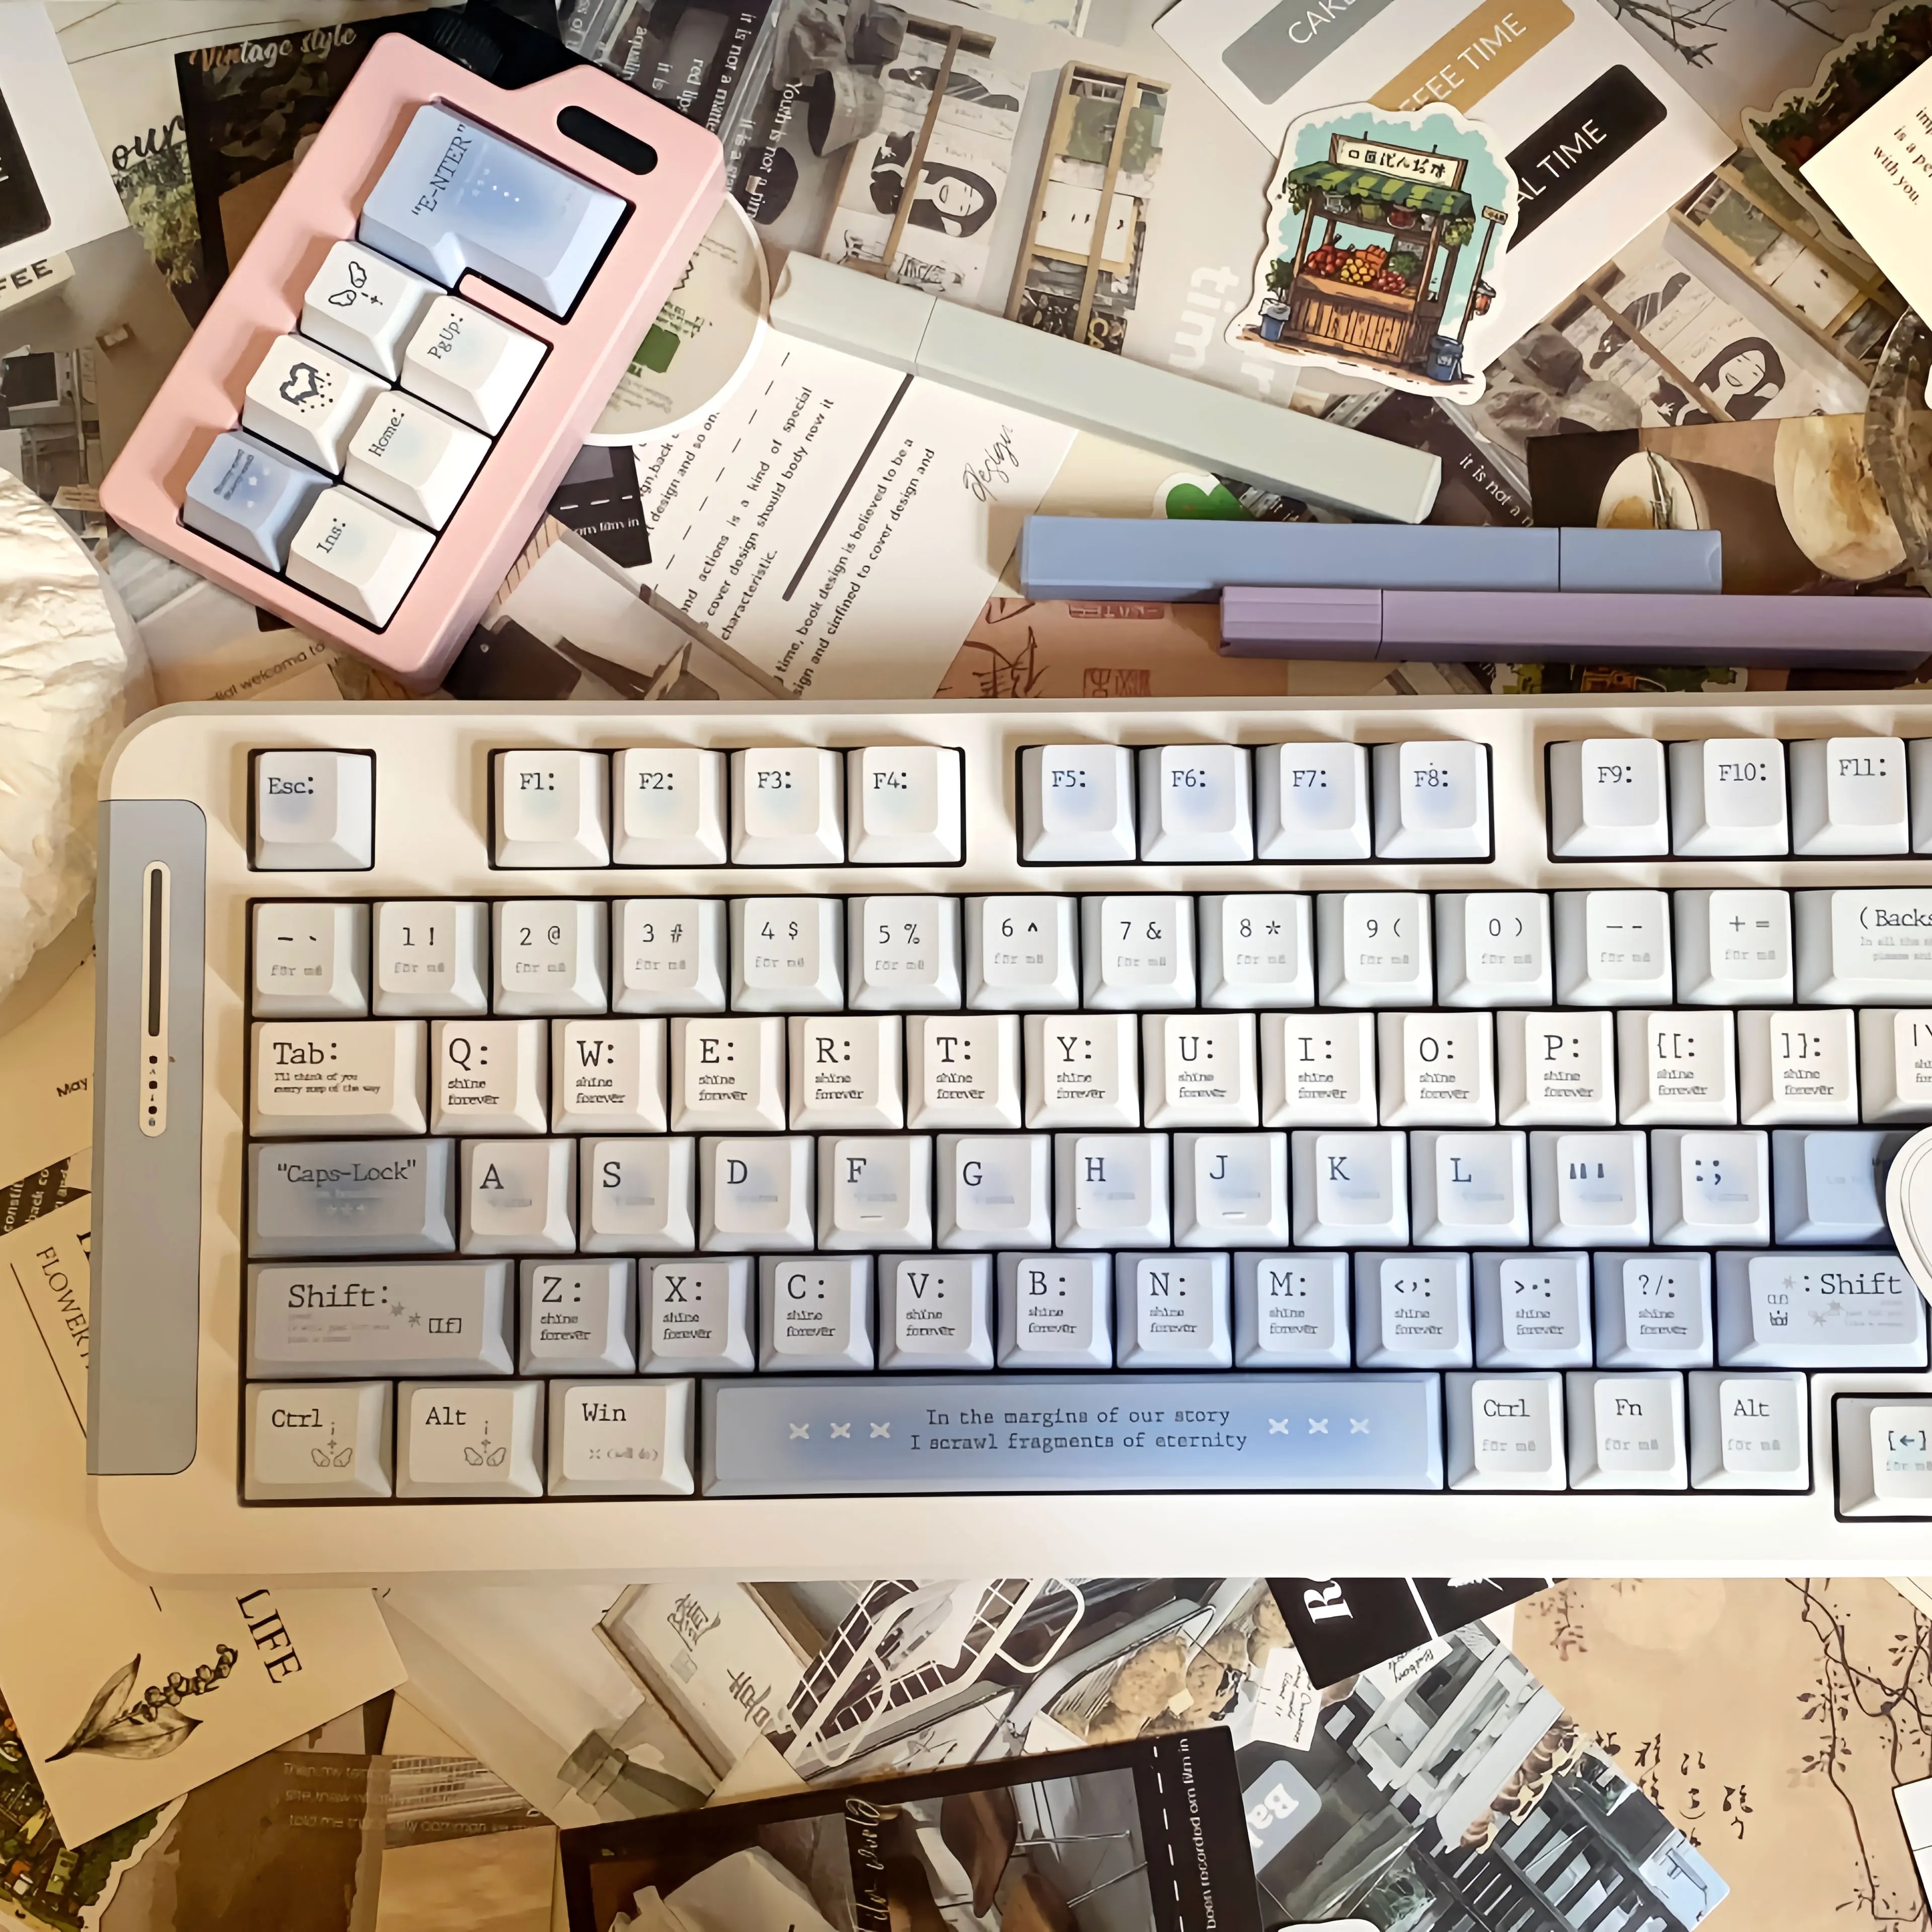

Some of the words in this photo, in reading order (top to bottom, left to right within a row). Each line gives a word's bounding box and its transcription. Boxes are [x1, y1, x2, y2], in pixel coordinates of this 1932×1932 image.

[1289, 0, 1348, 43] CAK
[190, 39, 292, 72] Vintage
[301, 24, 356, 59] style
[1458, 12, 1527, 71] TIME
[687, 59, 703, 85] red
[1537, 118, 1607, 179] TIME
[1874, 146, 1899, 176] with
[428, 313, 463, 359] PgUp:
[368, 408, 405, 457] Home:
[679, 450, 695, 476] and
[1472, 465, 1486, 482] is
[1485, 480, 1512, 506] not
[699, 535, 729, 582] actions
[741, 500, 749, 508] a
[746, 461, 770, 491] kind
[707, 580, 731, 616] cover
[757, 482, 786, 528] should
[781, 446, 808, 479] body
[805, 413, 825, 442] now
[316, 518, 346, 553] Ins:
[795, 602, 823, 635] book
[882, 469, 897, 481] to
[811, 637, 830, 665] and
[857, 565, 870, 578] to
[869, 524, 893, 560] cover
[917, 448, 935, 475] and
[758, 771, 791, 789] F3:
[1052, 770, 1086, 787] F5:
[1171, 769, 1206, 787] F6:
[1293, 770, 1327, 787] F7:
[1414, 769, 1448, 787] F8:
[1597, 765, 1632, 783] F9:
[1718, 763, 1766, 781] F10:
[1839, 758, 1886, 776] F11:
[268, 776, 314, 794] Esc:
[520, 772, 554, 791] F1:
[639, 772, 673, 790] F2:
[873, 772, 907, 789] F4:
[273, 1042, 337, 1065] Tab:
[449, 1038, 488, 1071] Q:
[576, 1040, 614, 1067] W:
[699, 1038, 734, 1064] E:
[816, 1037, 850, 1063] R:
[936, 1037, 971, 1063] T:
[1057, 1036, 1092, 1062] Y:
[1179, 1036, 1213, 1061] U:
[1298, 1037, 1332, 1061] I:
[1419, 1037, 1454, 1062] O:
[1544, 1034, 1579, 1061] P:
[57, 1077, 88, 1098] May
[479, 1163, 504, 1189] A
[603, 1161, 621, 1188] S
[727, 1159, 748, 1184] D
[846, 1157, 867, 1183] F
[962, 1161, 983, 1186] G
[1085, 1157, 1106, 1182] H
[1210, 1155, 1228, 1180] J
[1328, 1156, 1350, 1181] K
[1450, 1158, 1472, 1183] L
[288, 1283, 387, 1308] Shift:
[542, 1276, 581, 1303] Z:
[664, 1276, 701, 1302] X:
[787, 1274, 824, 1300] C:
[907, 1272, 944, 1299] V:
[1029, 1270, 1066, 1296] B:
[1149, 1271, 1186, 1297] N:
[1269, 1271, 1306, 1297] M:
[272, 1408, 323, 1427] Ctrl
[425, 1406, 466, 1425] Alt
[582, 1403, 626, 1421] Win
[926, 1409, 949, 1425] In
[960, 1408, 994, 1424] the
[1004, 1408, 1087, 1428] margins
[1097, 1407, 1119, 1423] of
[1129, 1411, 1165, 1423] our
[1175, 1410, 1230, 1426] story
[1484, 1399, 1531, 1417] Ctrl
[1615, 1399, 1643, 1416] Fn
[1734, 1399, 1769, 1417] Alt
[911, 1435, 920, 1450] I
[930, 1433, 998, 1450] scrawl
[1008, 1432, 1113, 1453] fragments
[1123, 1432, 1146, 1447] of
[1156, 1432, 1247, 1451] eternity
[236, 1588, 302, 1683] LIFE
